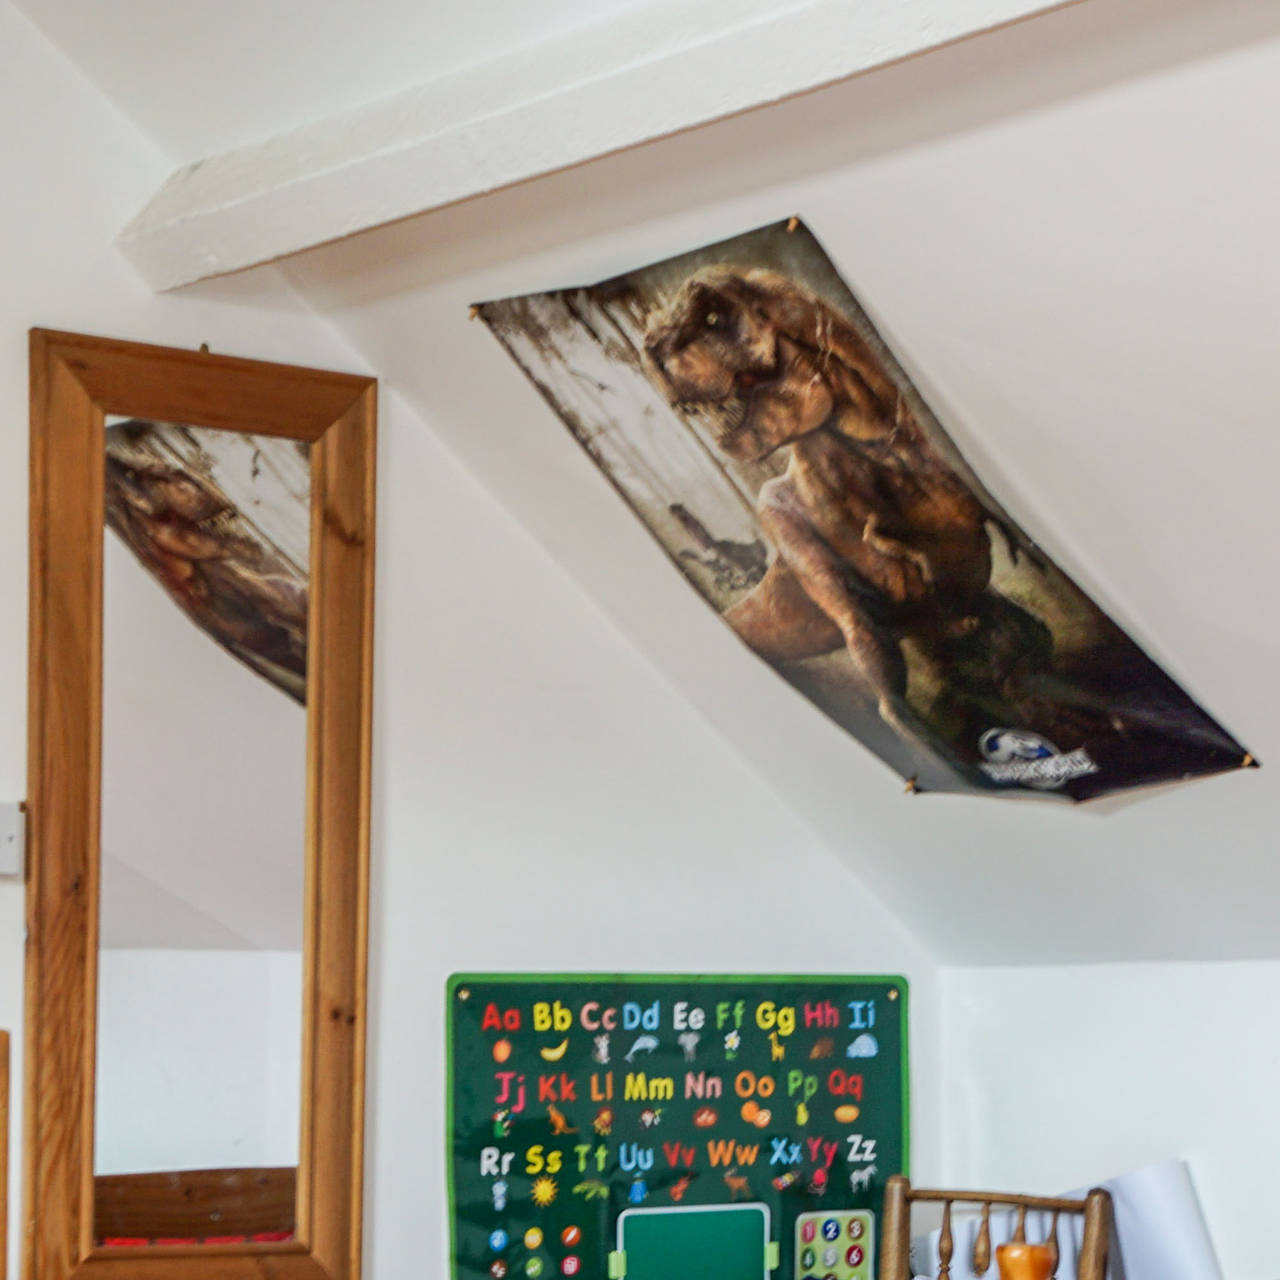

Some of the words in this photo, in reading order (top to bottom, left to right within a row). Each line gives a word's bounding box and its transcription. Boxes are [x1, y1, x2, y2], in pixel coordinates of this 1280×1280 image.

[482, 1003, 520, 1031] Aa
[533, 1002, 572, 1031] Bb
[580, 1002, 617, 1030] Cc
[623, 1001, 660, 1030] Dd
[673, 1002, 705, 1030] Ee
[716, 1000, 744, 1030] Ff
[756, 1001, 795, 1036] Gg
[804, 1001, 839, 1028] Hh
[848, 1001, 875, 1029] Ii
[494, 1071, 526, 1114] Jj
[538, 1073, 576, 1102] Kk
[591, 1071, 613, 1099] Ll
[625, 1073, 673, 1100] Mm
[684, 1070, 721, 1098] Nn
[734, 1070, 775, 1098] Oo
[787, 1069, 817, 1104] Pp
[828, 1068, 863, 1106] Qq
[480, 1147, 515, 1176] Rr
[525, 1145, 563, 1174] Ss
[574, 1142, 608, 1172] Tt
[619, 1143, 654, 1171] Uu
[663, 1141, 696, 1168] Vv
[706, 1139, 760, 1167] Ww
[770, 1137, 802, 1164] Xx
[807, 1136, 837, 1169] Yy
[847, 1133, 877, 1161] Zz
